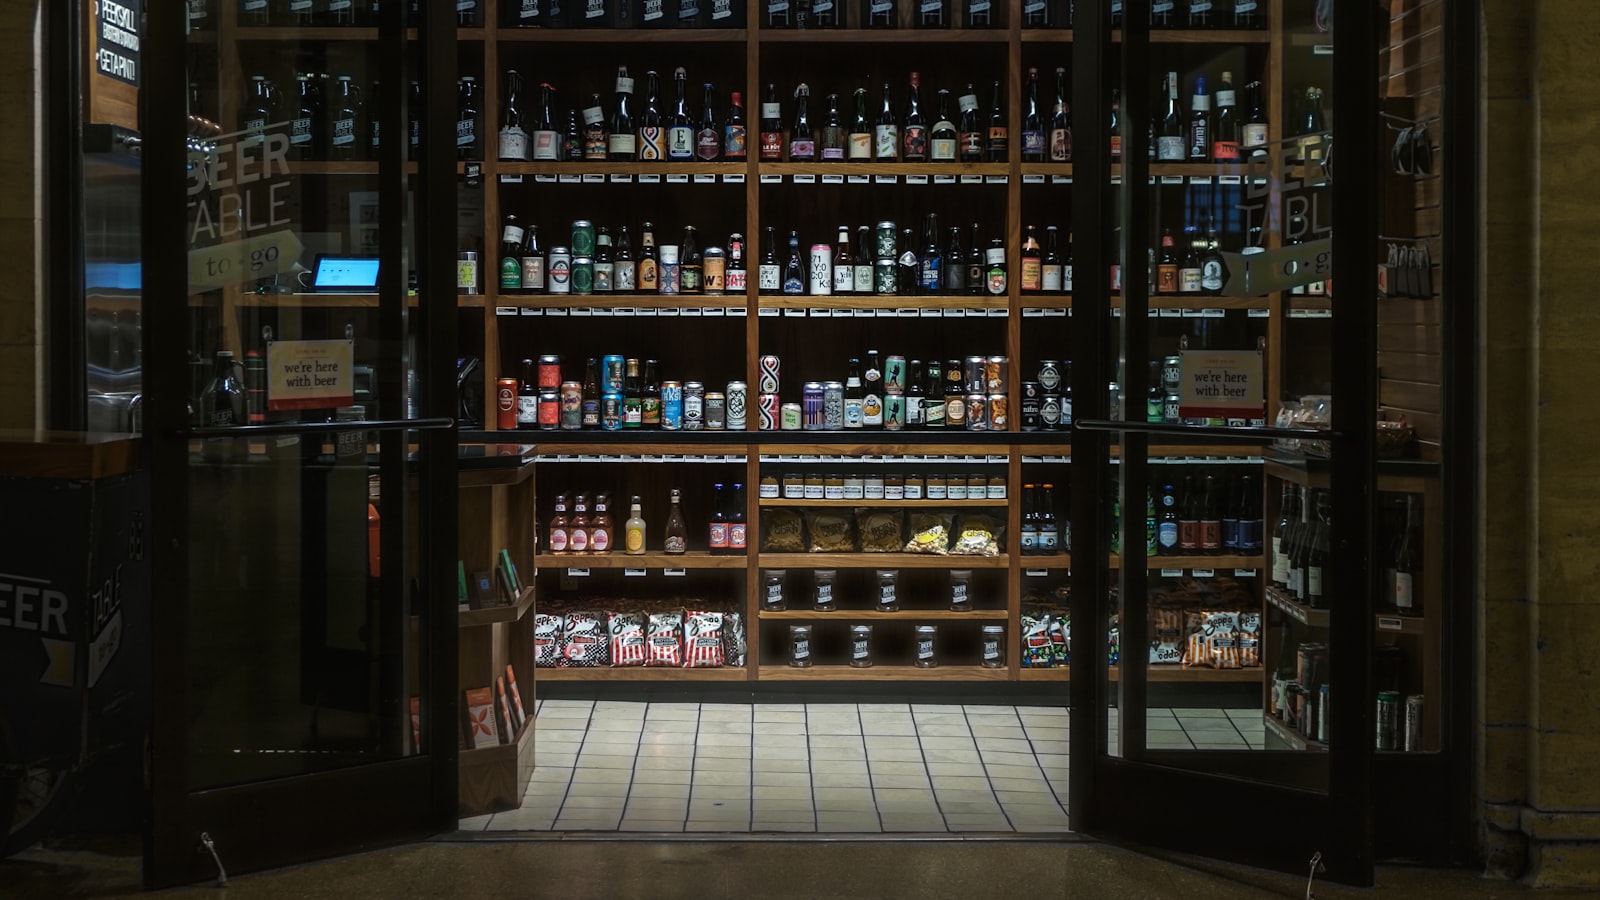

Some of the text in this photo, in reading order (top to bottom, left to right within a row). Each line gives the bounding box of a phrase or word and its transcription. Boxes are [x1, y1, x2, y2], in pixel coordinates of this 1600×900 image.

[187, 133, 290, 196] BEER
[1234, 193, 1332, 246] TABL
[251, 246, 279, 271] go
[285, 360, 339, 374] we're here
[1194, 370, 1247, 383] we're here
[287, 375, 337, 388] with beer
[1196, 384, 1246, 397] with beer
[0, 582, 69, 635] EER
